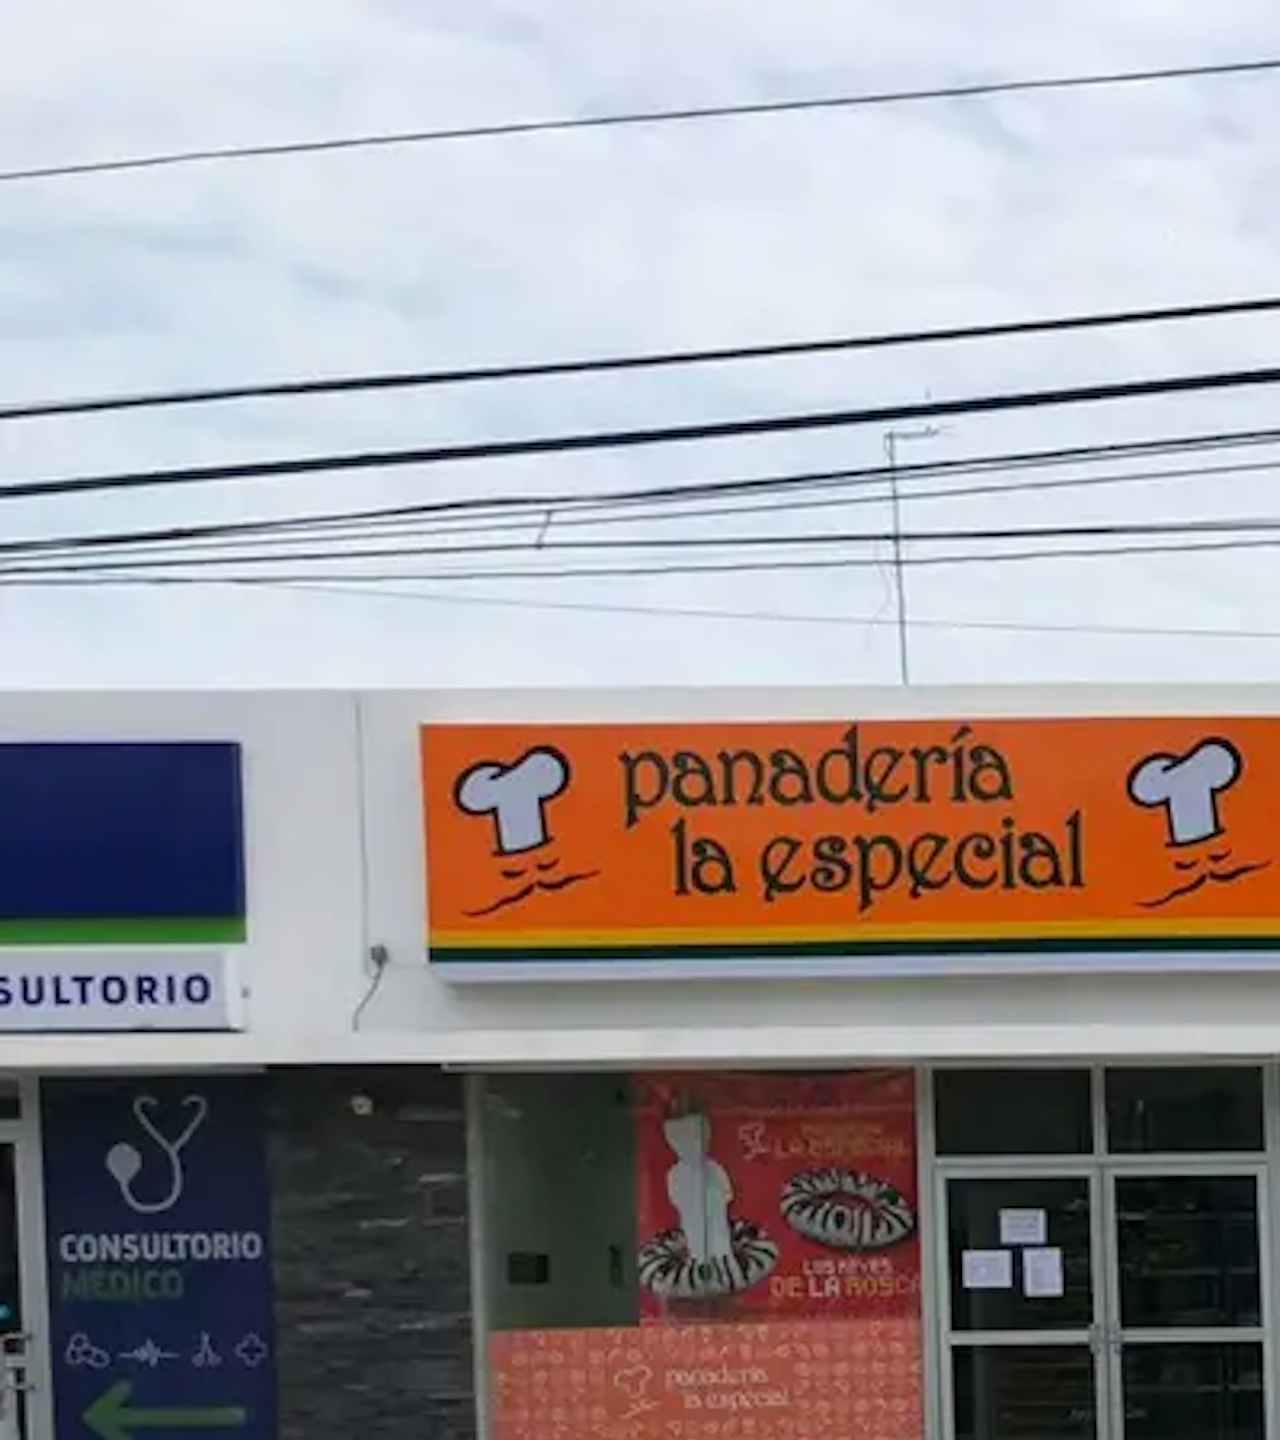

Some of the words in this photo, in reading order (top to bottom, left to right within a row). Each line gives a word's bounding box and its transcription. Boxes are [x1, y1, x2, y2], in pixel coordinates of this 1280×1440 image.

[619, 723, 1013, 830] panadería
[671, 817, 737, 895] la
[760, 809, 1085, 913] especial
[60, 1232, 263, 1263] CONSULTORIO
[808, 1275, 840, 1297] LA
